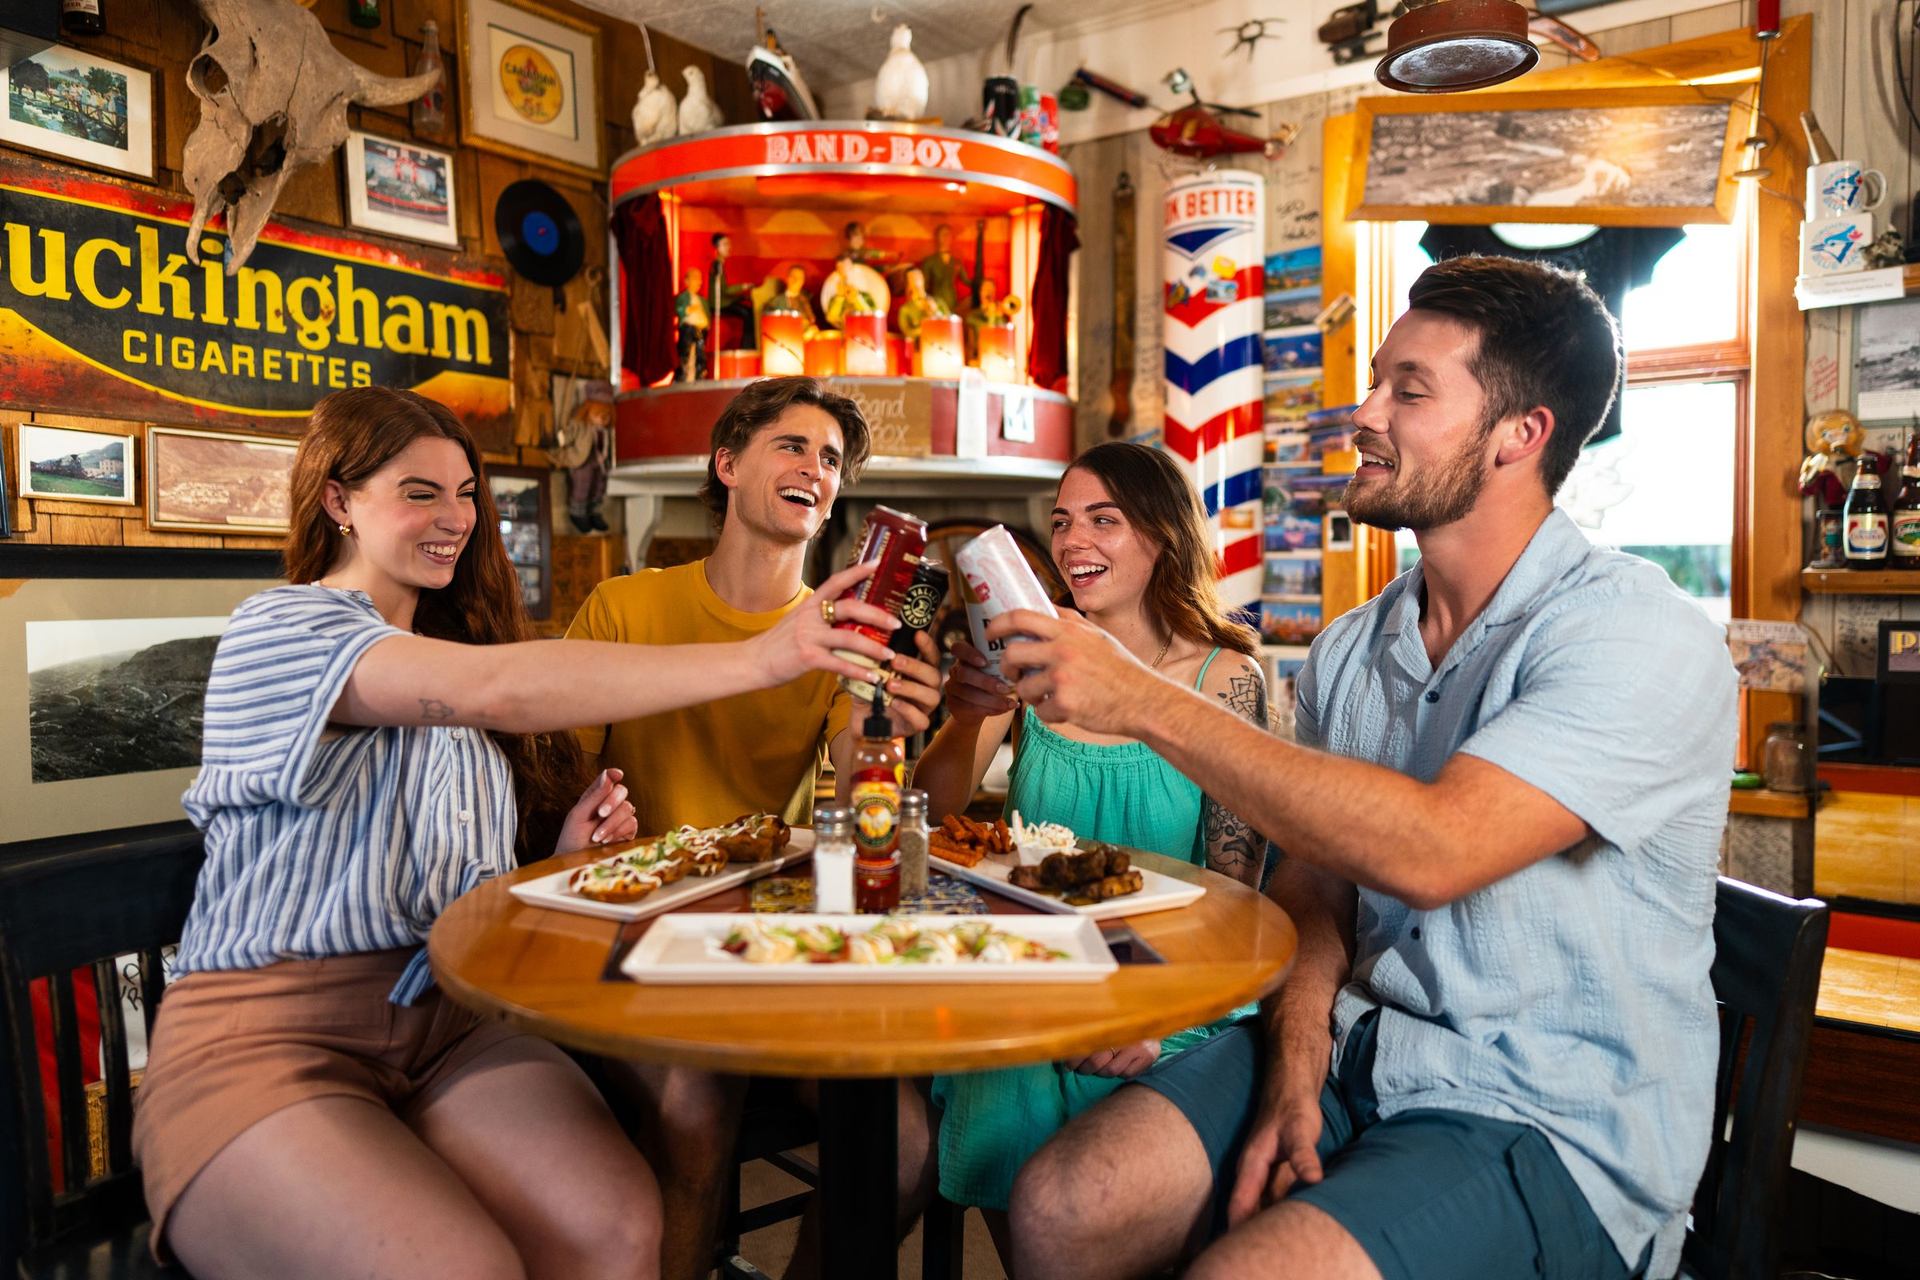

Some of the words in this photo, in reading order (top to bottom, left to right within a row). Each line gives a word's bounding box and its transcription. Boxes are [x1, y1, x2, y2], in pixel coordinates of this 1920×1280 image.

[766, 134, 964, 170] BAND-BOX
[1187, 189, 1257, 218] BETTER
[0, 221, 492, 366] uckingham
[122, 328, 373, 389] CIGARETTES
[911, 587, 938, 604] VALLE
[1890, 631, 1920, 655] P
